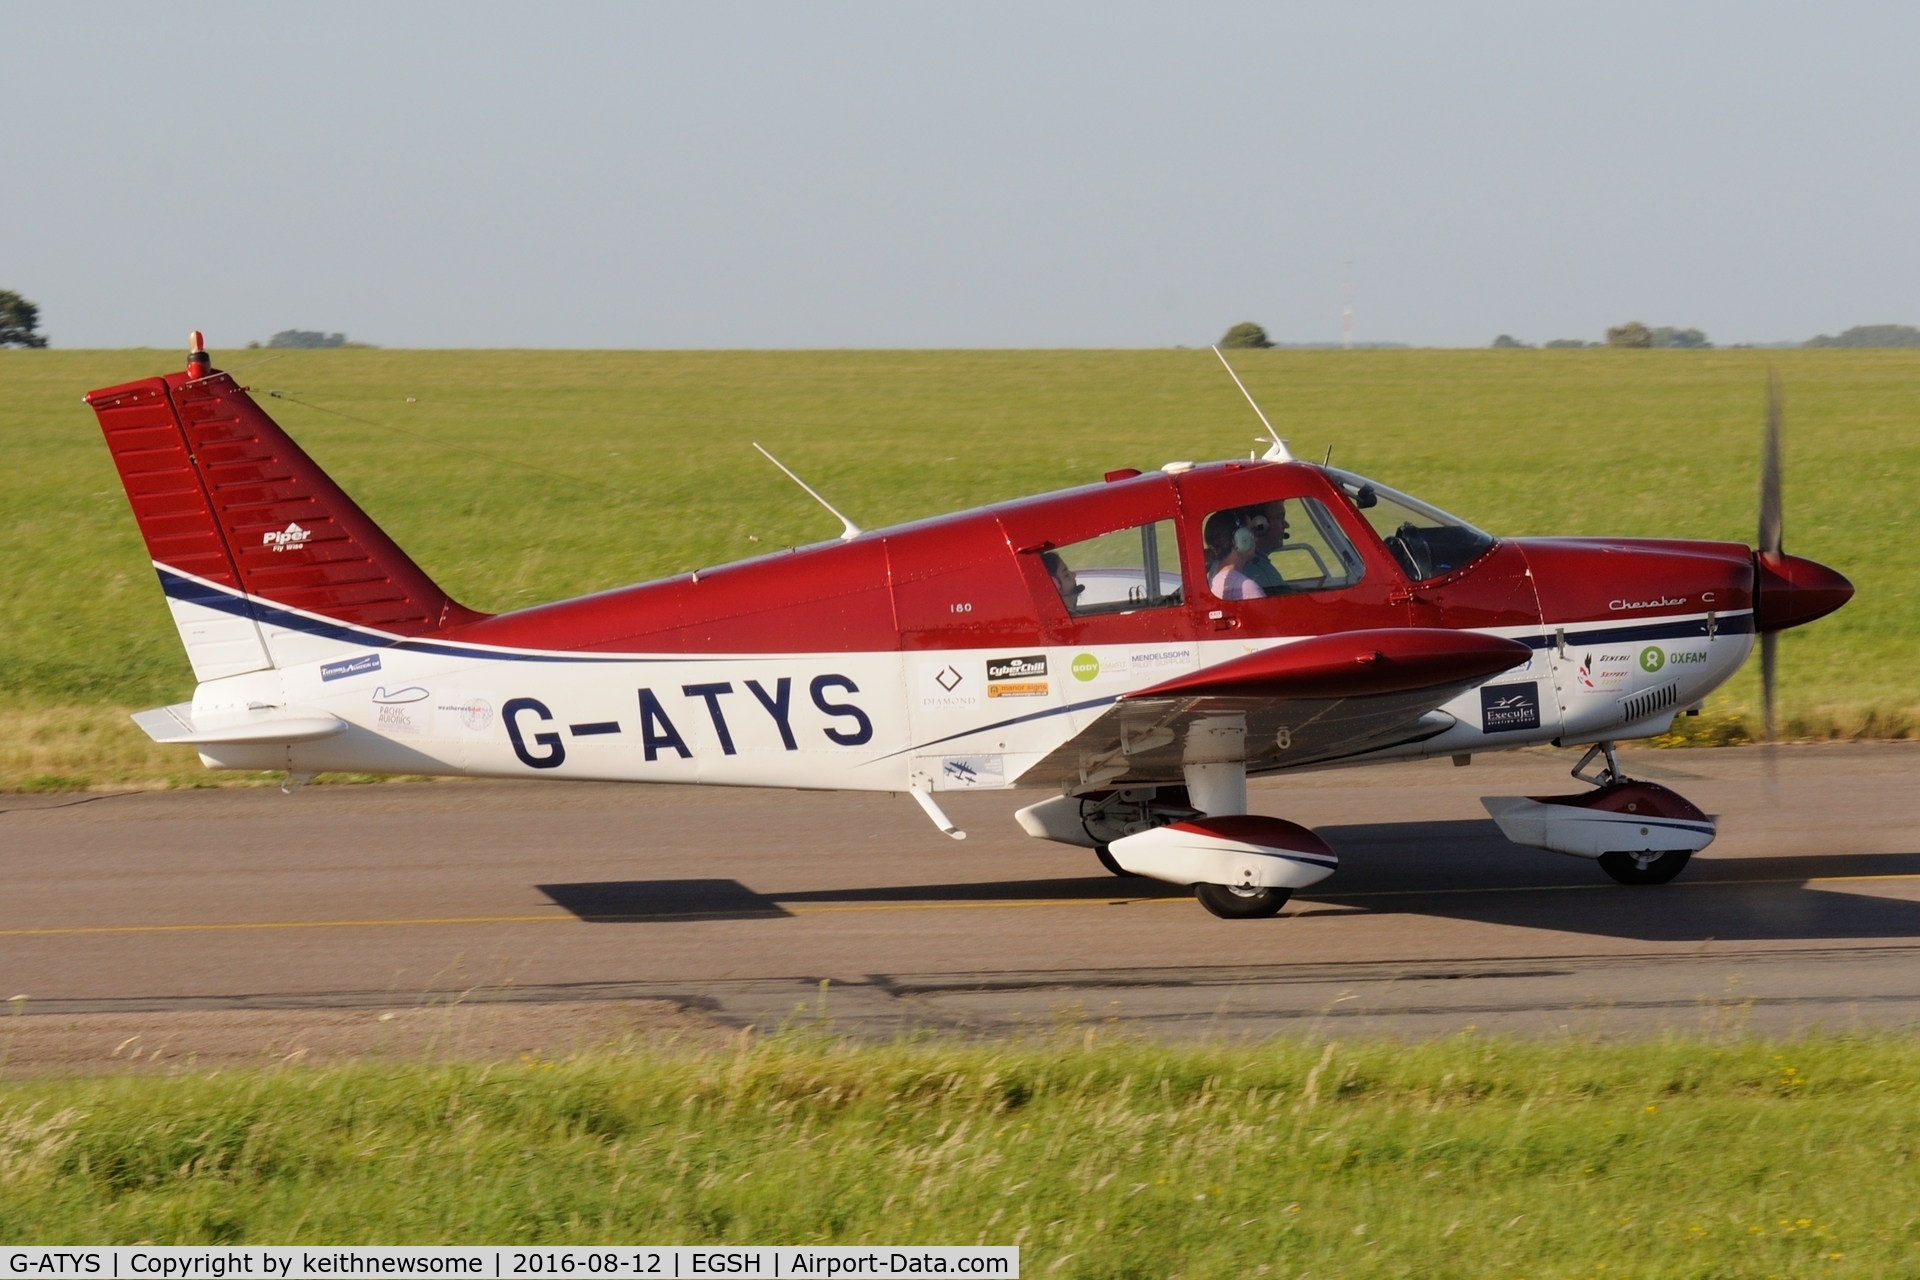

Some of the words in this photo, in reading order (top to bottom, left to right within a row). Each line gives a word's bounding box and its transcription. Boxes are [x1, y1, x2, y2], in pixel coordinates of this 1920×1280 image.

[263, 530, 311, 545] Piper
[1608, 595, 1687, 610] Cherokee
[1701, 592, 1716, 602] C
[950, 603, 972, 613] 180
[1132, 650, 1190, 662] MENDELSSOHN
[1670, 652, 1707, 664] OXFAM
[1073, 664, 1098, 673] BODY
[1132, 660, 1152, 669] PILOT
[1155, 656, 1191, 667] SUPPLIES
[989, 662, 1045, 676] CyberChill
[1026, 683, 1047, 693] signs
[923, 697, 976, 706] DIAMOND
[380, 706, 405, 717] PACIFIC
[1487, 708, 1534, 720] ExecuJet
[501, 673, 873, 769] G-ATYS
